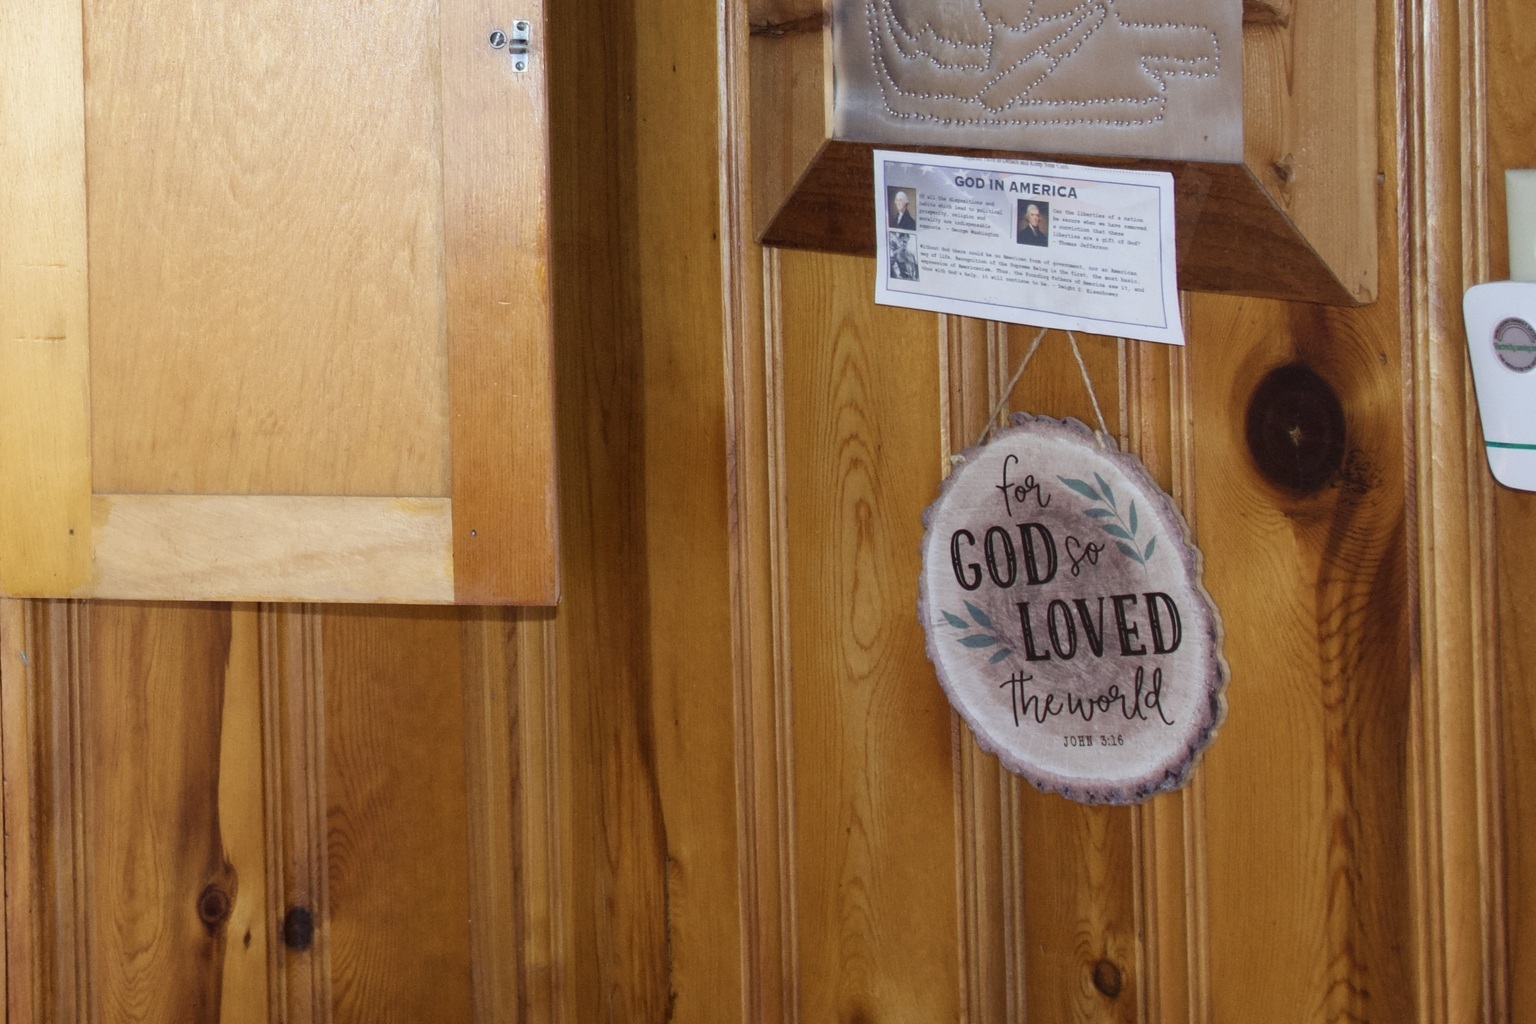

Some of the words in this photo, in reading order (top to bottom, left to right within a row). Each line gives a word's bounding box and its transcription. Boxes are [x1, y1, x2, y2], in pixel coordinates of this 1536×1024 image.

[954, 176, 985, 189] GOD
[989, 179, 1005, 192] IN
[1009, 181, 1078, 199] AMERICA
[996, 454, 1050, 517] for
[950, 522, 1058, 591] GOD
[1066, 535, 1105, 576] so
[1016, 592, 1182, 661] LOVED
[999, 670, 1064, 727] the
[1068, 666, 1175, 726] world
[1063, 735, 1093, 747] JOHN
[1100, 734, 1124, 747] 3:16
